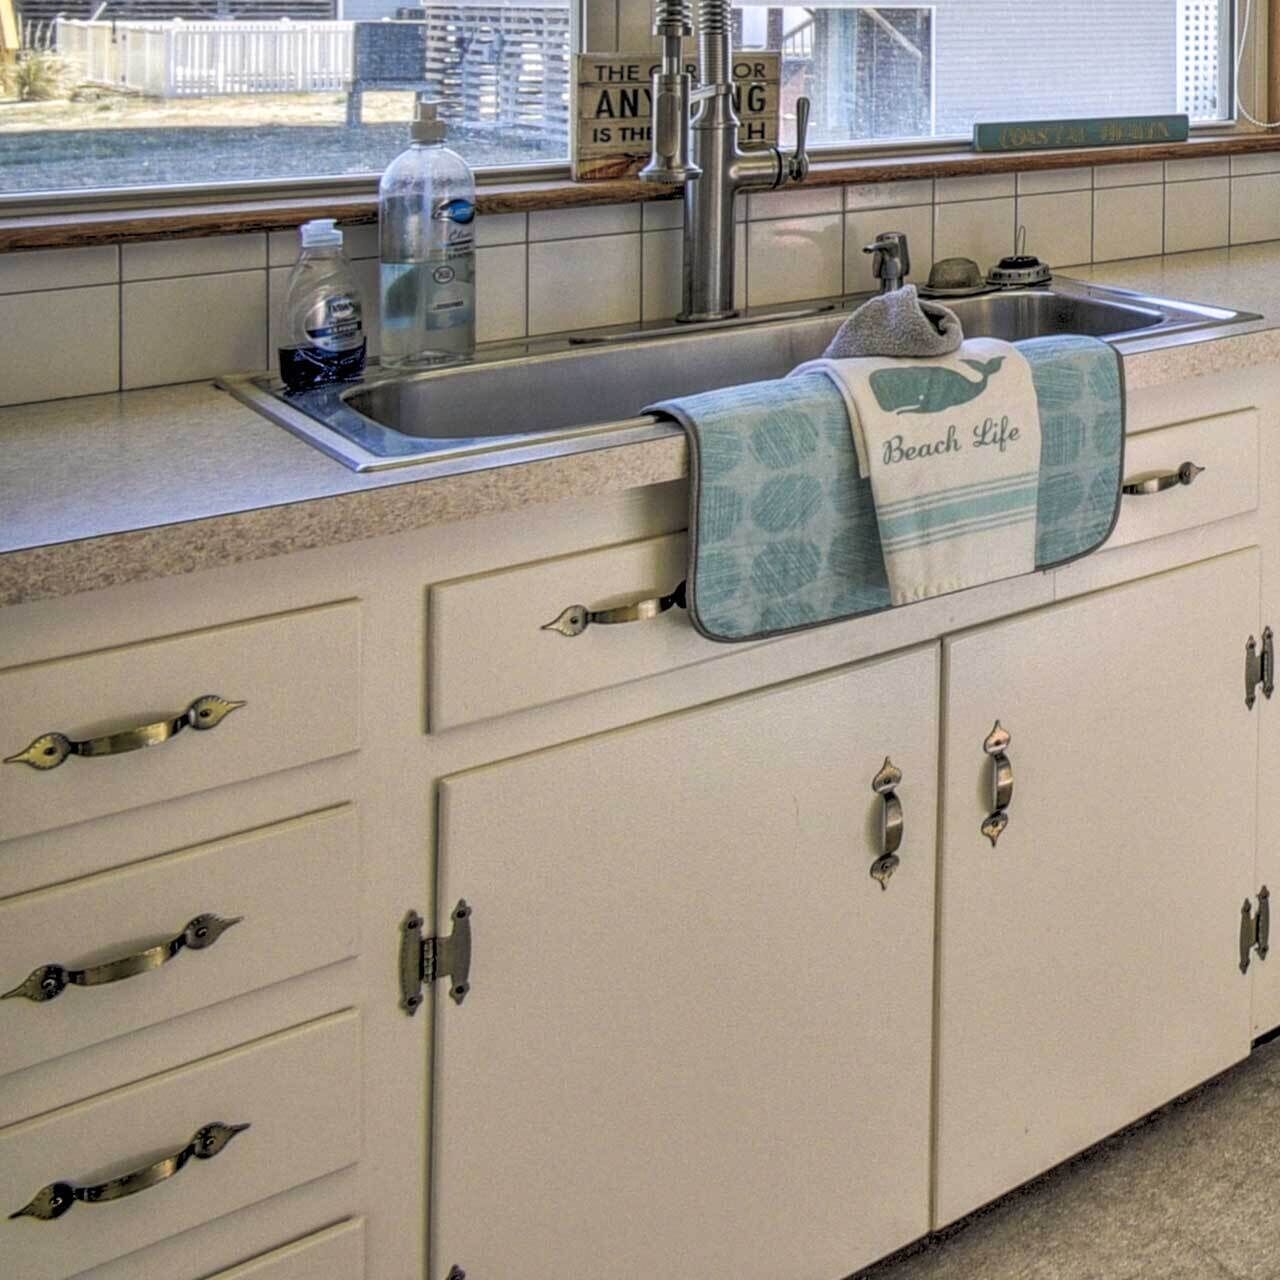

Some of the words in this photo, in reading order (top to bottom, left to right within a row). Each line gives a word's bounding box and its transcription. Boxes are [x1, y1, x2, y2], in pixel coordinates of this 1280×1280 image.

[594, 65, 639, 81] THE
[733, 62, 765, 79] OR
[592, 127, 612, 143] IS
[882, 425, 962, 465] Beach
[973, 415, 1021, 453] Life
